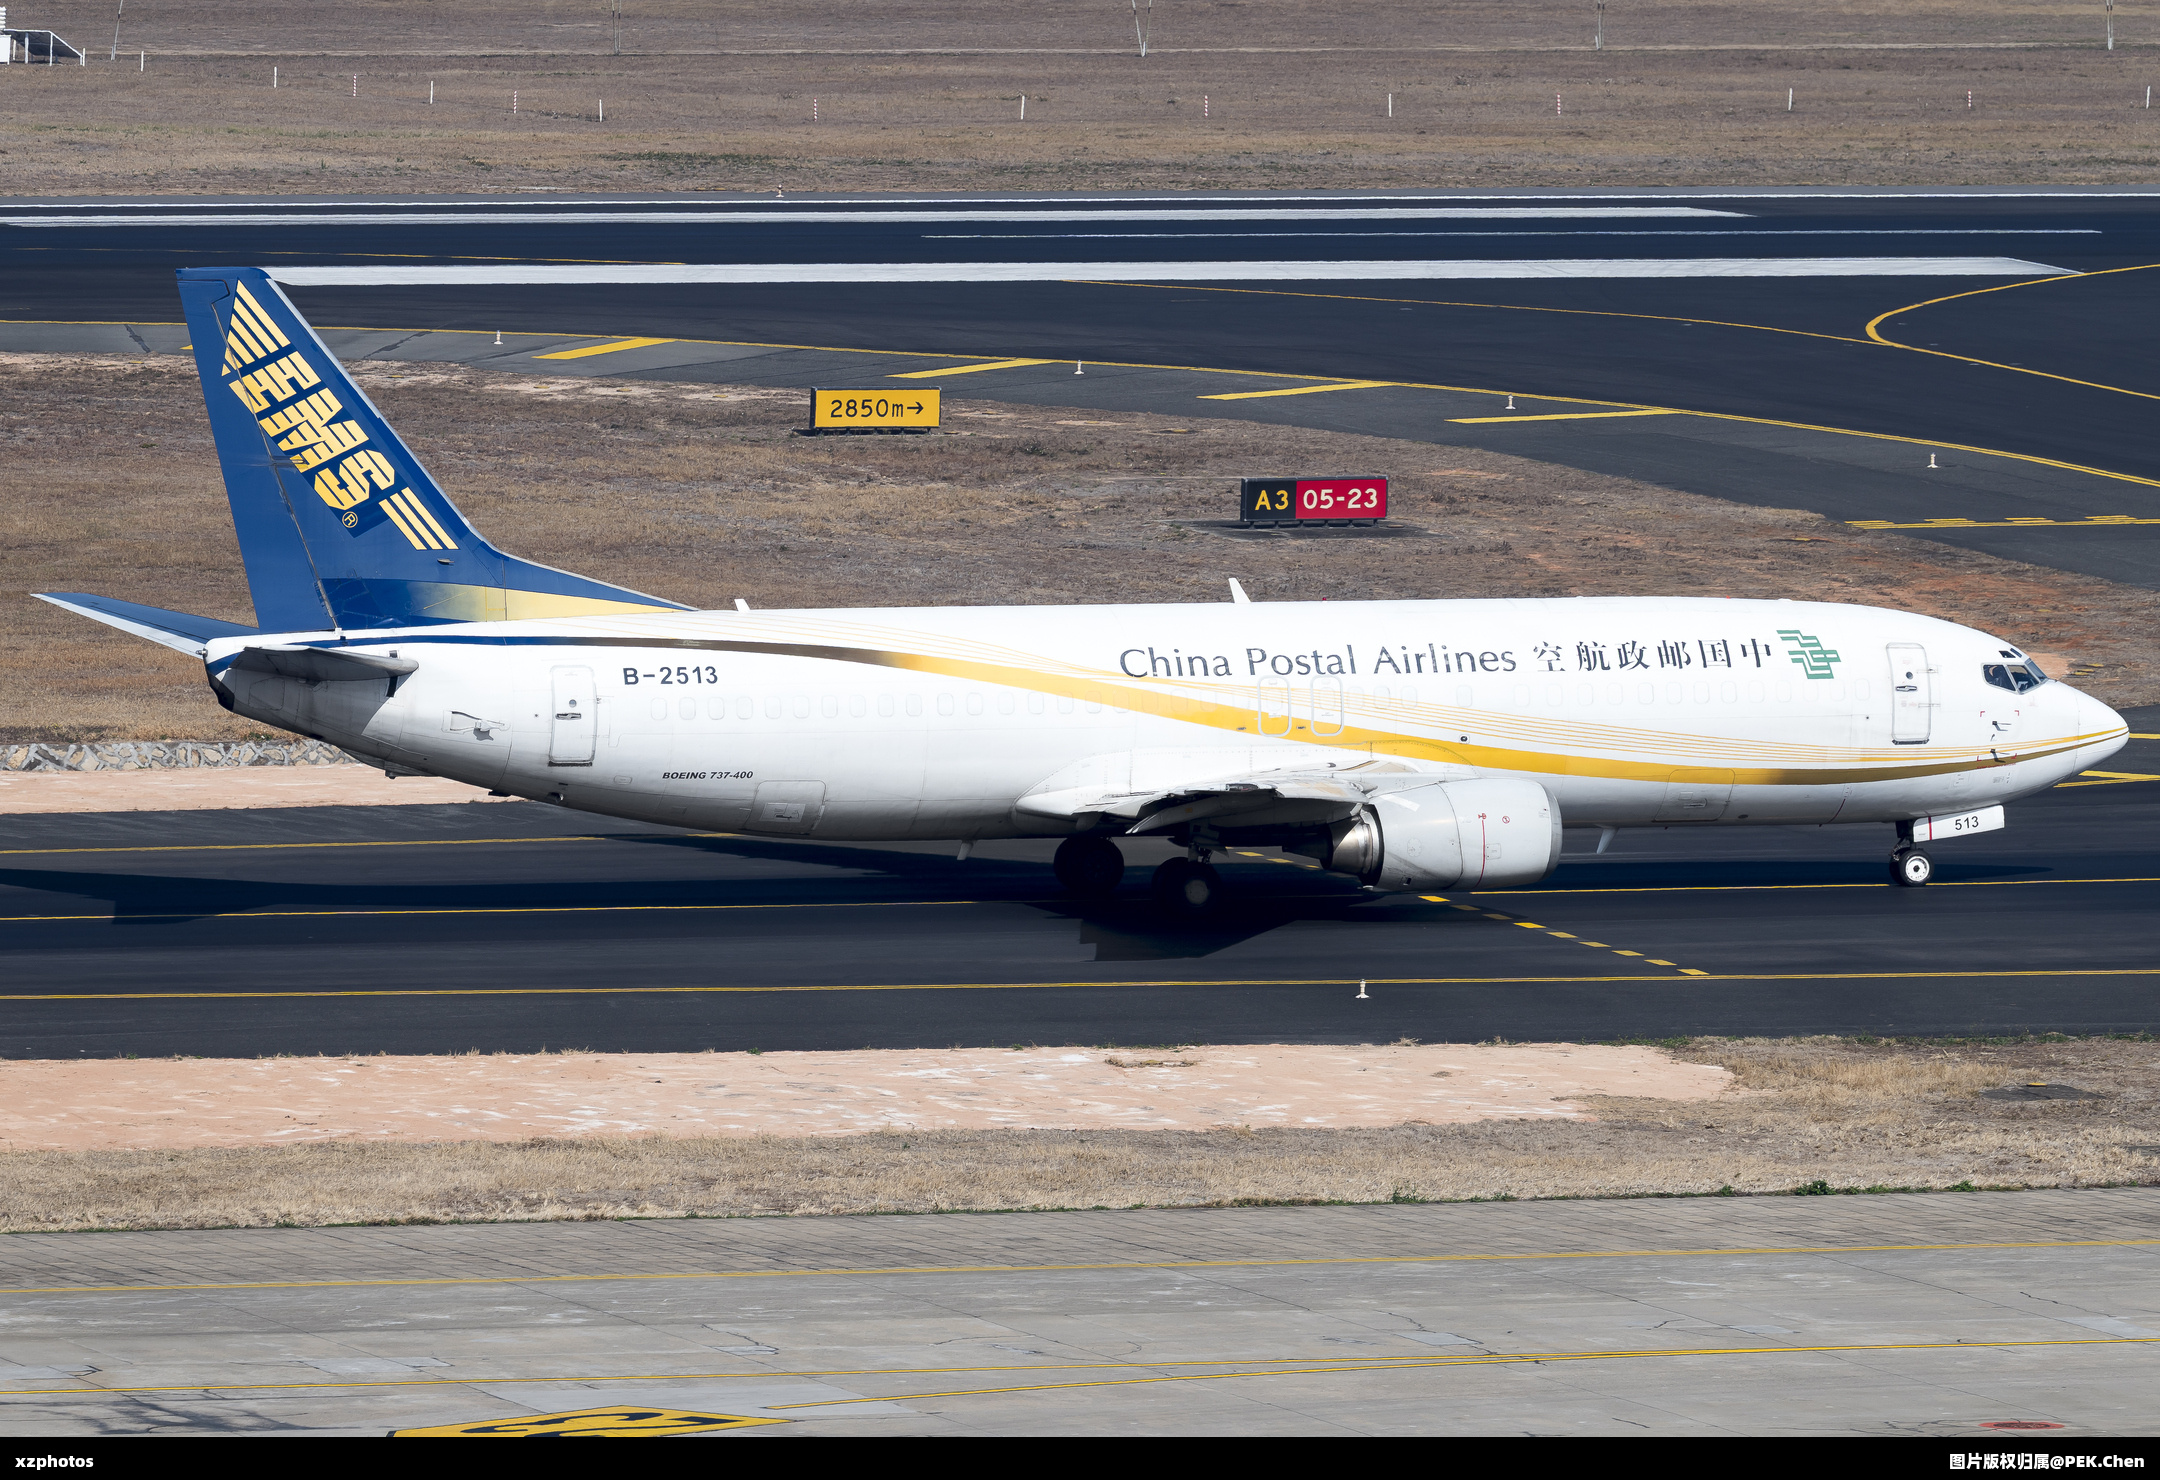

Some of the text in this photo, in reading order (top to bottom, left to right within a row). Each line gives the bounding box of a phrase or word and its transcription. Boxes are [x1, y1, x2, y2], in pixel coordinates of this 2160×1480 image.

[830, 398, 904, 418] 2850m
[228, 350, 395, 510] EMS
[1254, 488, 1378, 511] A3 05-23
[1120, 643, 1517, 678] China Postal Airlines
[623, 666, 718, 685] B-2513
[662, 770, 754, 780] BOEING 737-400
[1954, 815, 1980, 831] 513
